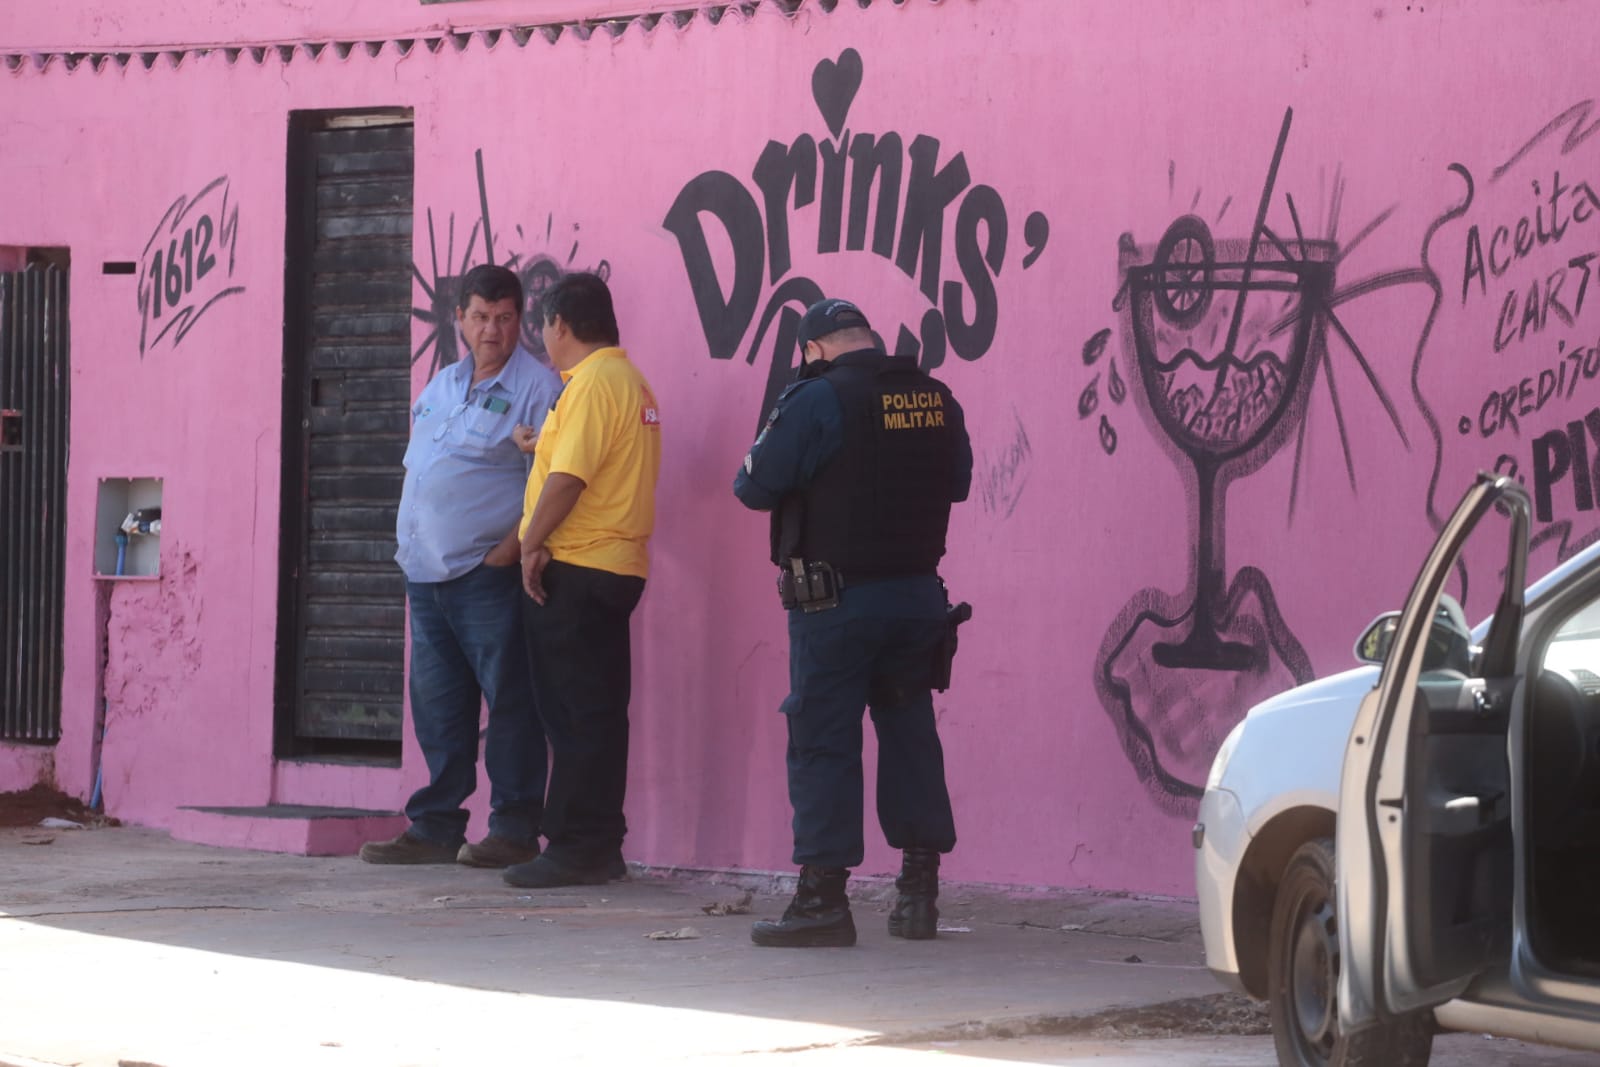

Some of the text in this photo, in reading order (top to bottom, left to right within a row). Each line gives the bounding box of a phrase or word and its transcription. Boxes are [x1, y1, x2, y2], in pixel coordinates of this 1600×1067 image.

[149, 214, 217, 319] 1612
[1494, 252, 1600, 354] CART
[882, 390, 943, 410] POLÍCIA
[884, 410, 945, 430] MILITAR
